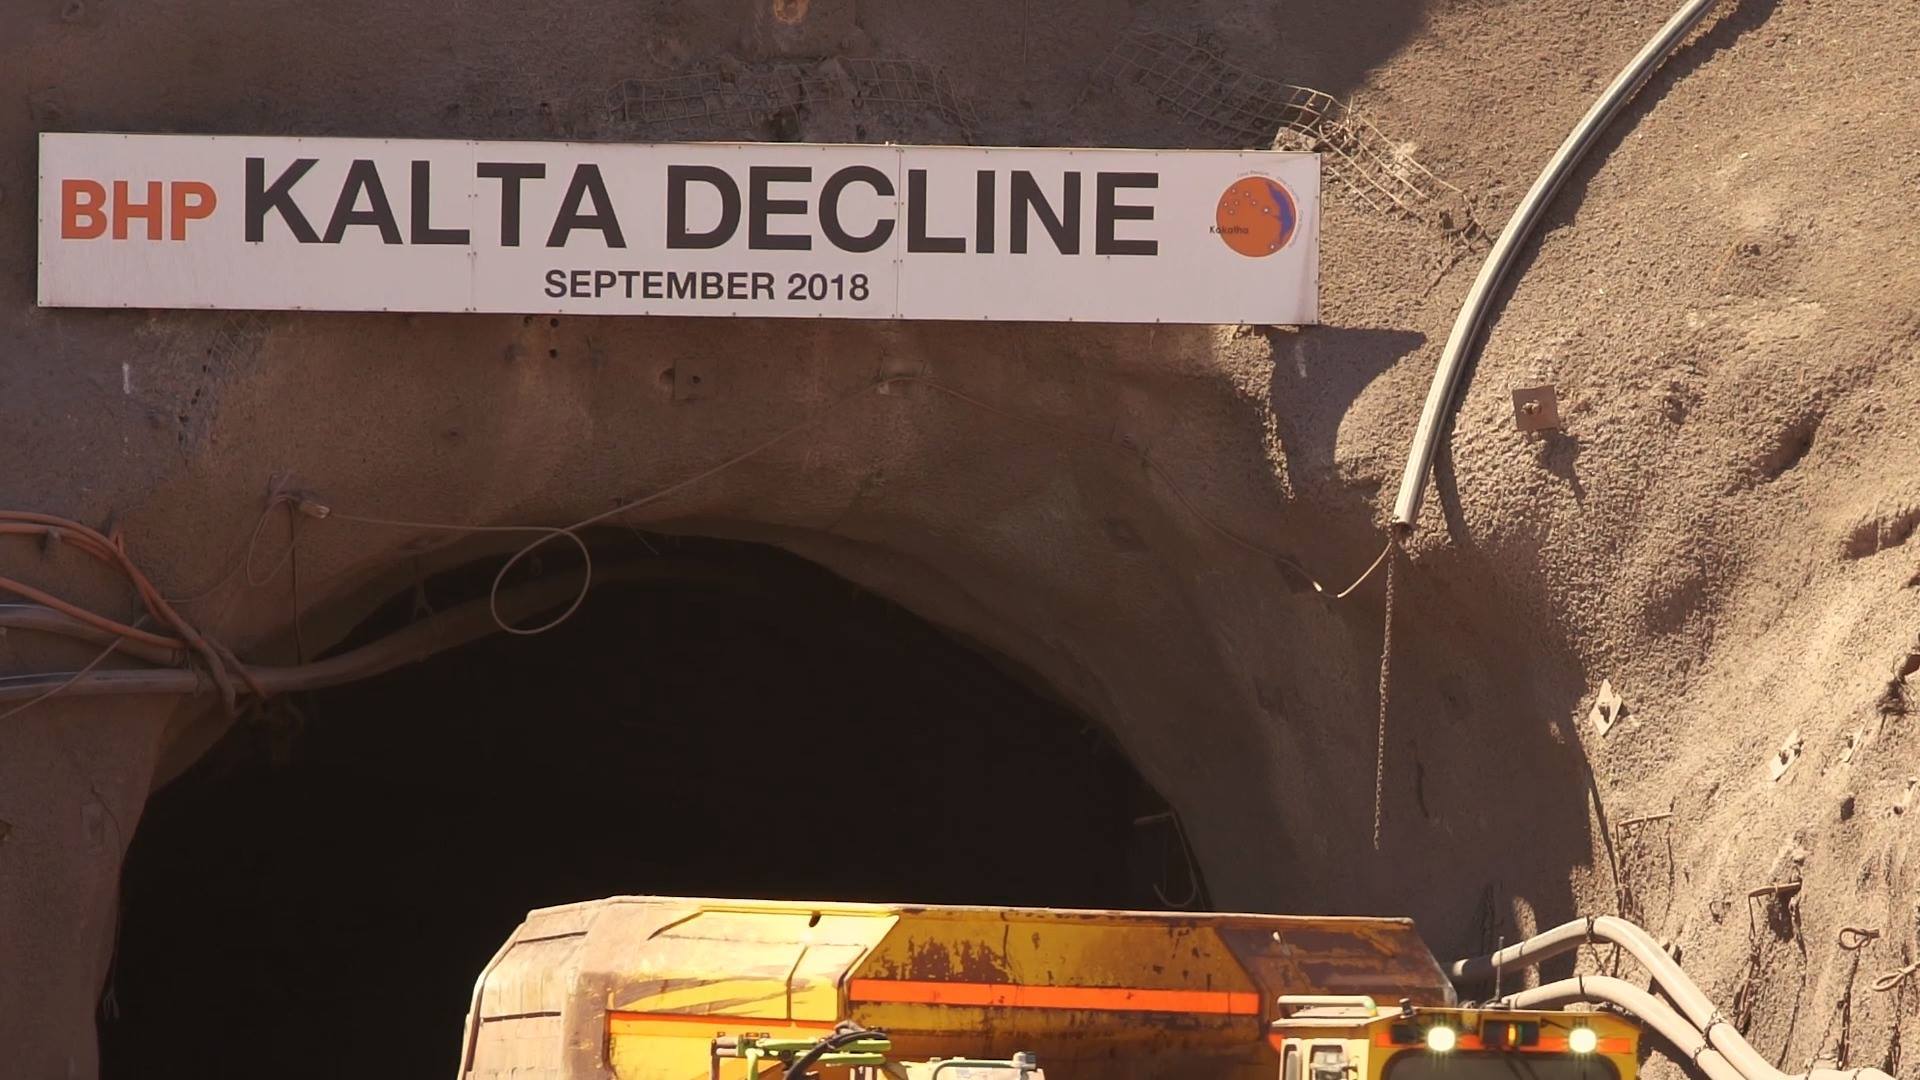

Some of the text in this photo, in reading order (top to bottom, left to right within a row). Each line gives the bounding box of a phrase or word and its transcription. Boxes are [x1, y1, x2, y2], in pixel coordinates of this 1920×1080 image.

[61, 179, 217, 241] BHP
[245, 157, 1158, 255] KALTA DECLINE
[545, 269, 869, 301] SEPTEMBER 2018
